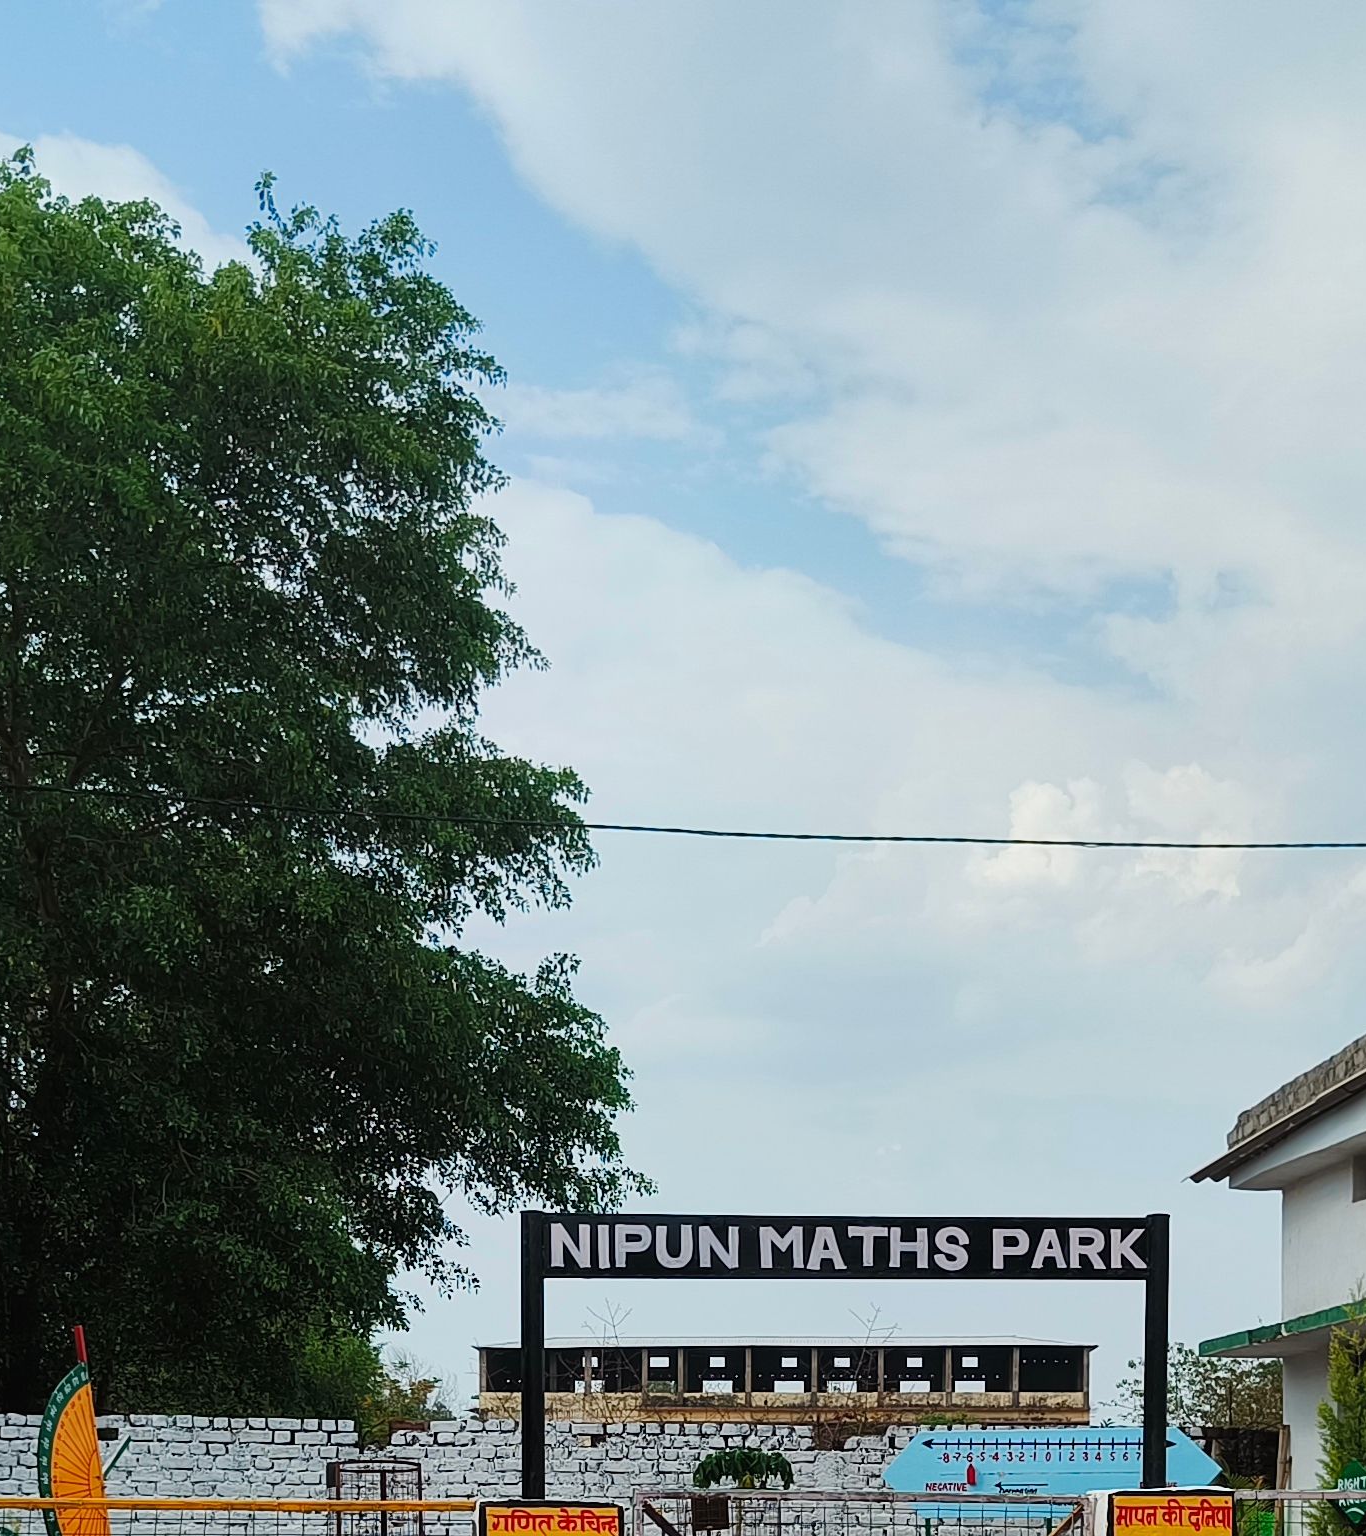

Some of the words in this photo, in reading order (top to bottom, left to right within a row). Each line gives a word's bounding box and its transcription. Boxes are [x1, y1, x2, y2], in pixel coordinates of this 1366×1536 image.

[550, 1222, 740, 1271] NIPUN
[759, 1225, 969, 1272] MATHS
[992, 1227, 1148, 1271] PARK
[925, 1482, 968, 1492] NEGATIVE
[491, 1509, 554, 1536] गणित
[1115, 1506, 1158, 1527] मापन
[1159, 1499, 1186, 1526] की
